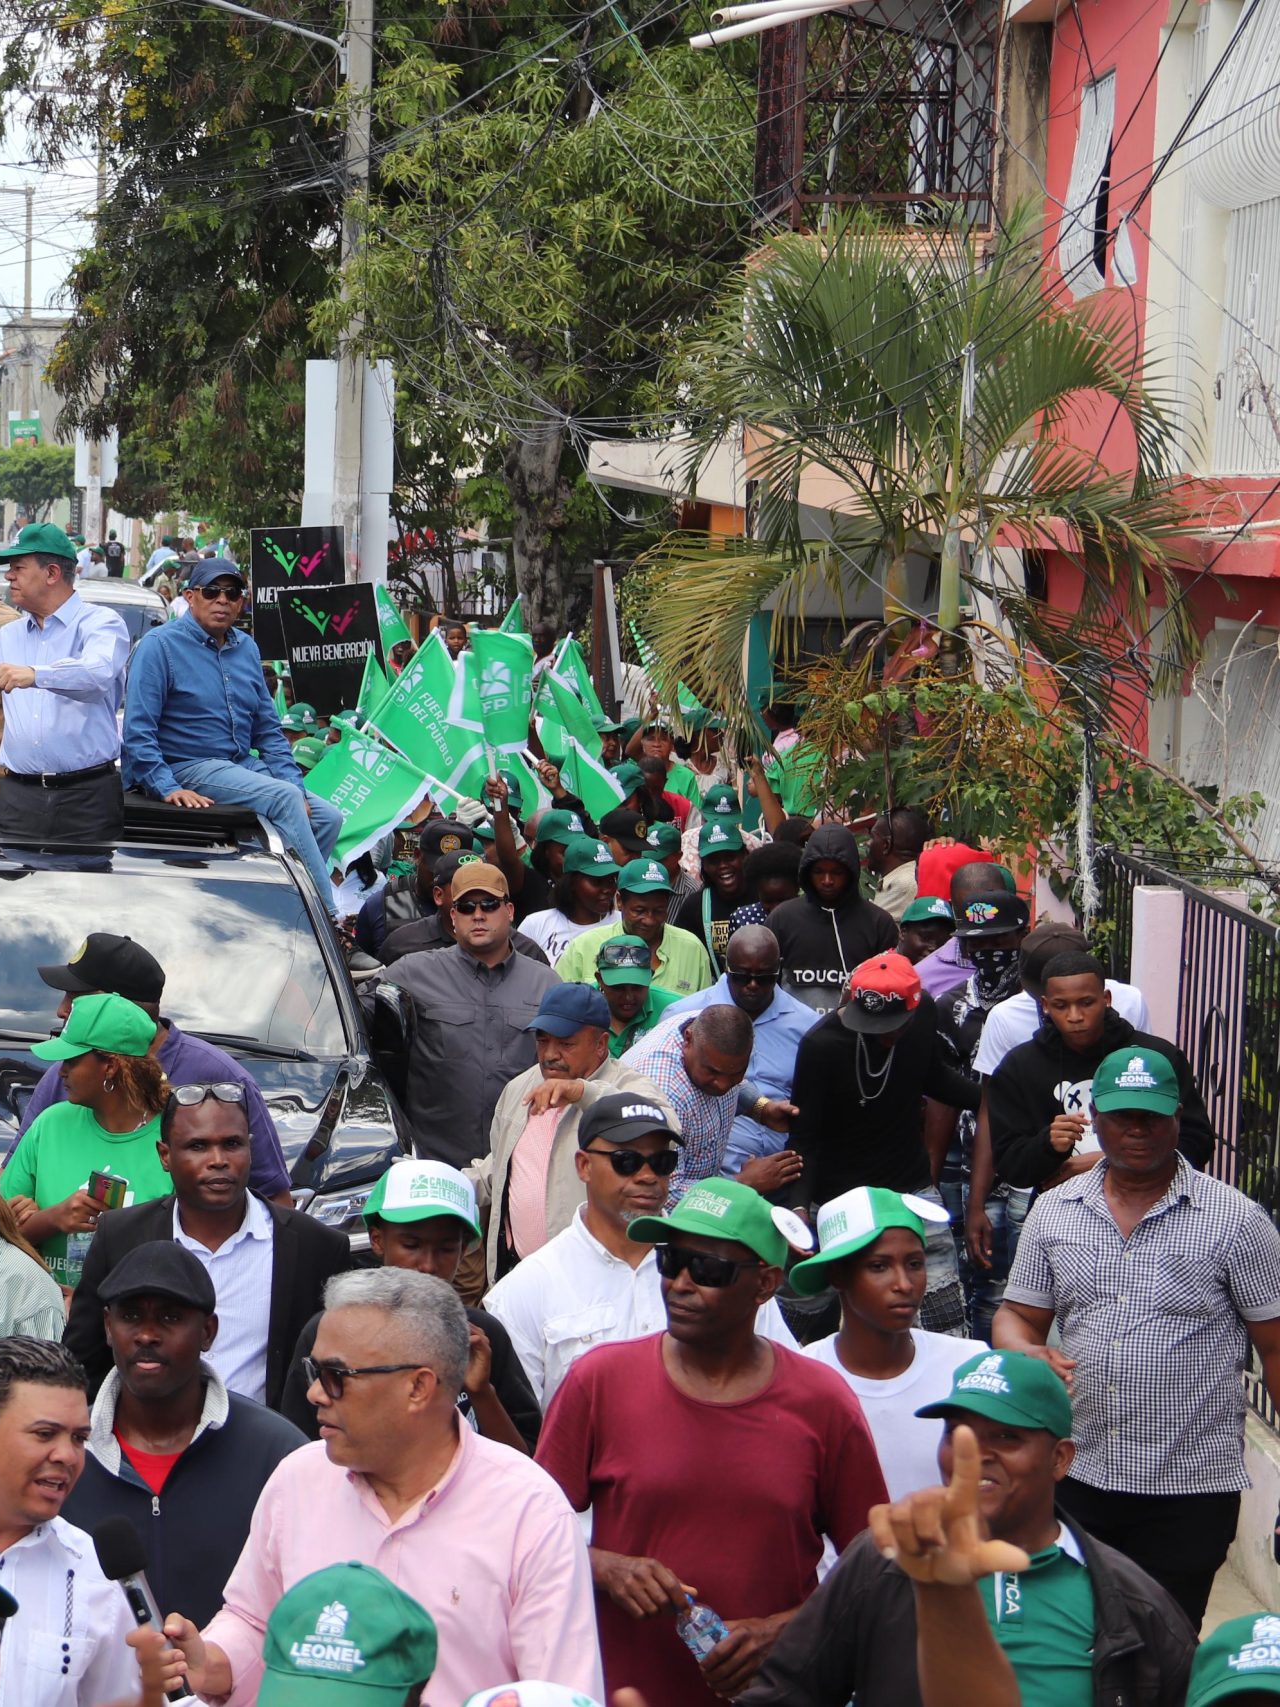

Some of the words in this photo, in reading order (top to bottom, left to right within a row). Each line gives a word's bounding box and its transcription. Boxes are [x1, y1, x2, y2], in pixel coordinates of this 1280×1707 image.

[292, 646, 320, 663] NUEVA
[323, 638, 376, 661] GENERACIÓN
[418, 692, 450, 734] FUERZA
[481, 698, 508, 713] FP
[408, 703, 426, 725] DEL
[425, 722, 453, 767] PUEBLO
[793, 969, 849, 985] TOUCH
[1115, 1075, 1157, 1085] LEONEL
[621, 1104, 666, 1121] KING
[430, 1177, 469, 1197] CANDELIER
[956, 1374, 1010, 1394] LEONEL
[290, 1642, 366, 1666] LEONEL
[1228, 1645, 1280, 1667] LEON
[295, 1658, 353, 1673] PRESIDENTE
